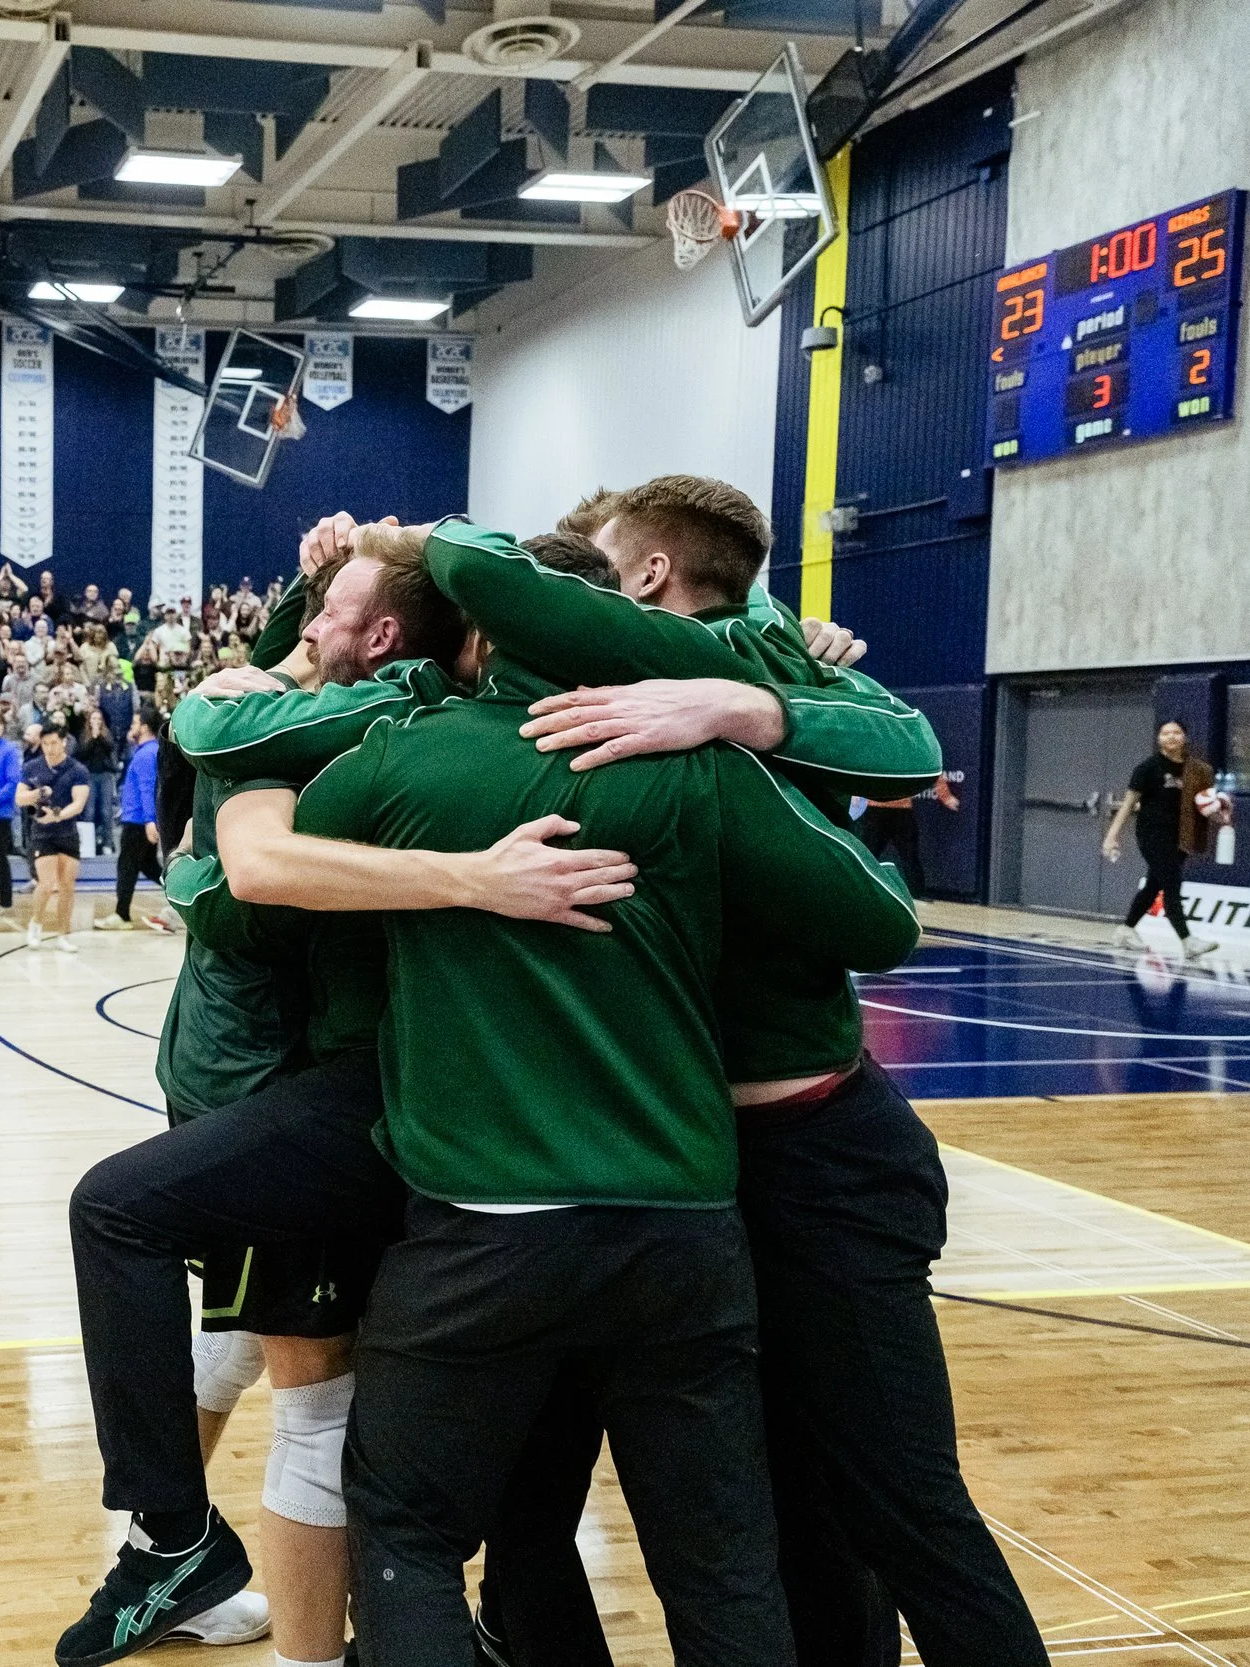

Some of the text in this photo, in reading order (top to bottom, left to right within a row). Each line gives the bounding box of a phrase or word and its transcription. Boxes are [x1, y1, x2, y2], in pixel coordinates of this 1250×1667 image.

[1090, 222, 1157, 283] 1:00
[1173, 228, 1225, 287] 25
[1001, 289, 1045, 341] 23
[1077, 304, 1124, 341] period
[1180, 317, 1217, 342] fouls
[13, 359, 42, 369] SOCCER
[1076, 343, 1122, 372] player
[1189, 349, 1211, 385] 2
[995, 370, 1024, 392] fouls
[1092, 374, 1111, 409] 3
[1178, 396, 1210, 418] won
[1075, 418, 1112, 443] game
